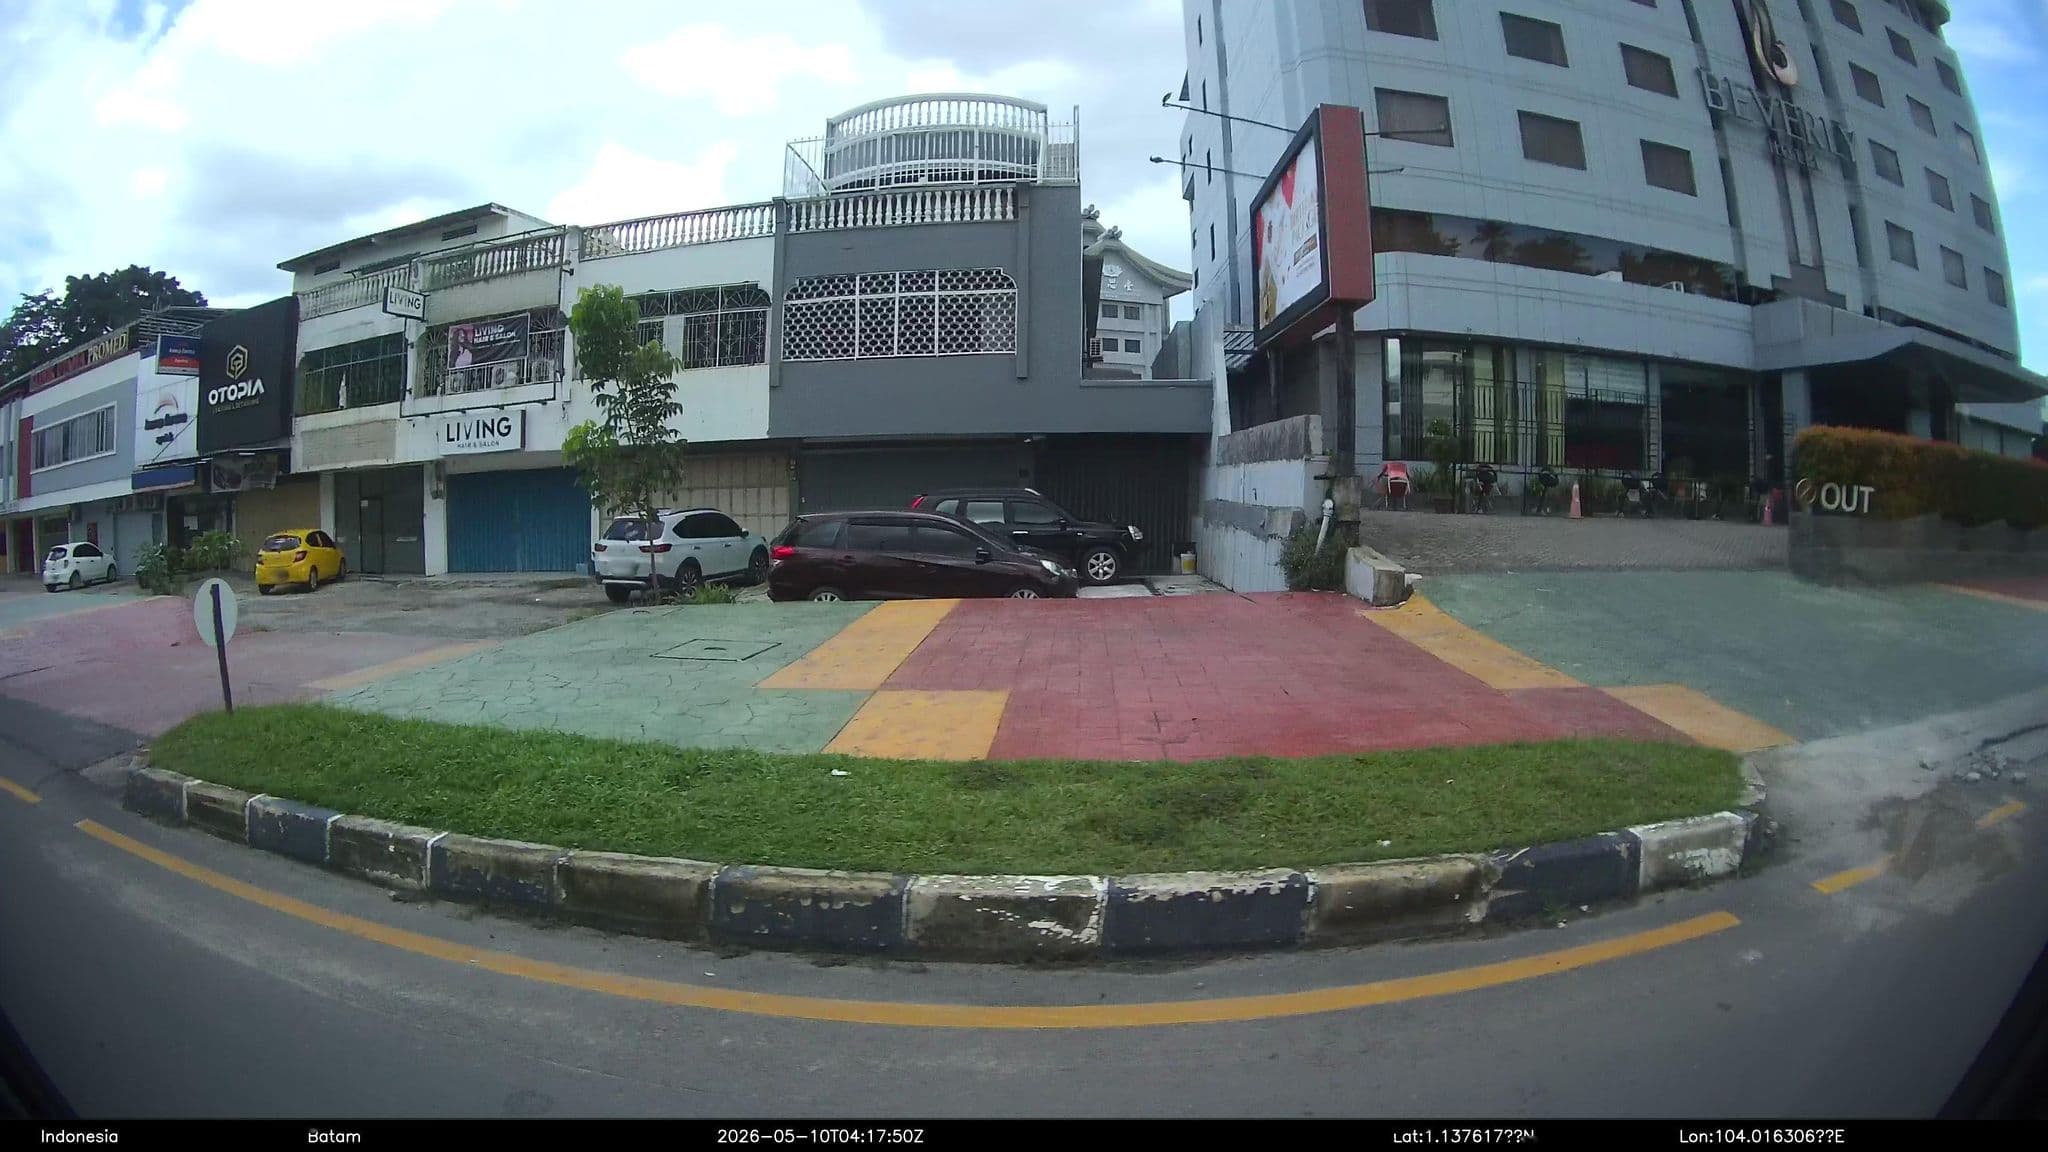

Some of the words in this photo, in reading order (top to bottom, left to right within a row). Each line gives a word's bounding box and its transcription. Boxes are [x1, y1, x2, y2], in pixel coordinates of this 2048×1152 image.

[1696, 66, 1855, 162] BEVERLY
[390, 291, 421, 310] LIVING
[474, 324, 505, 337] LIVING
[208, 378, 265, 405] OTOPIA
[446, 416, 512, 442] LIVING
[1820, 482, 1875, 513] OUT
